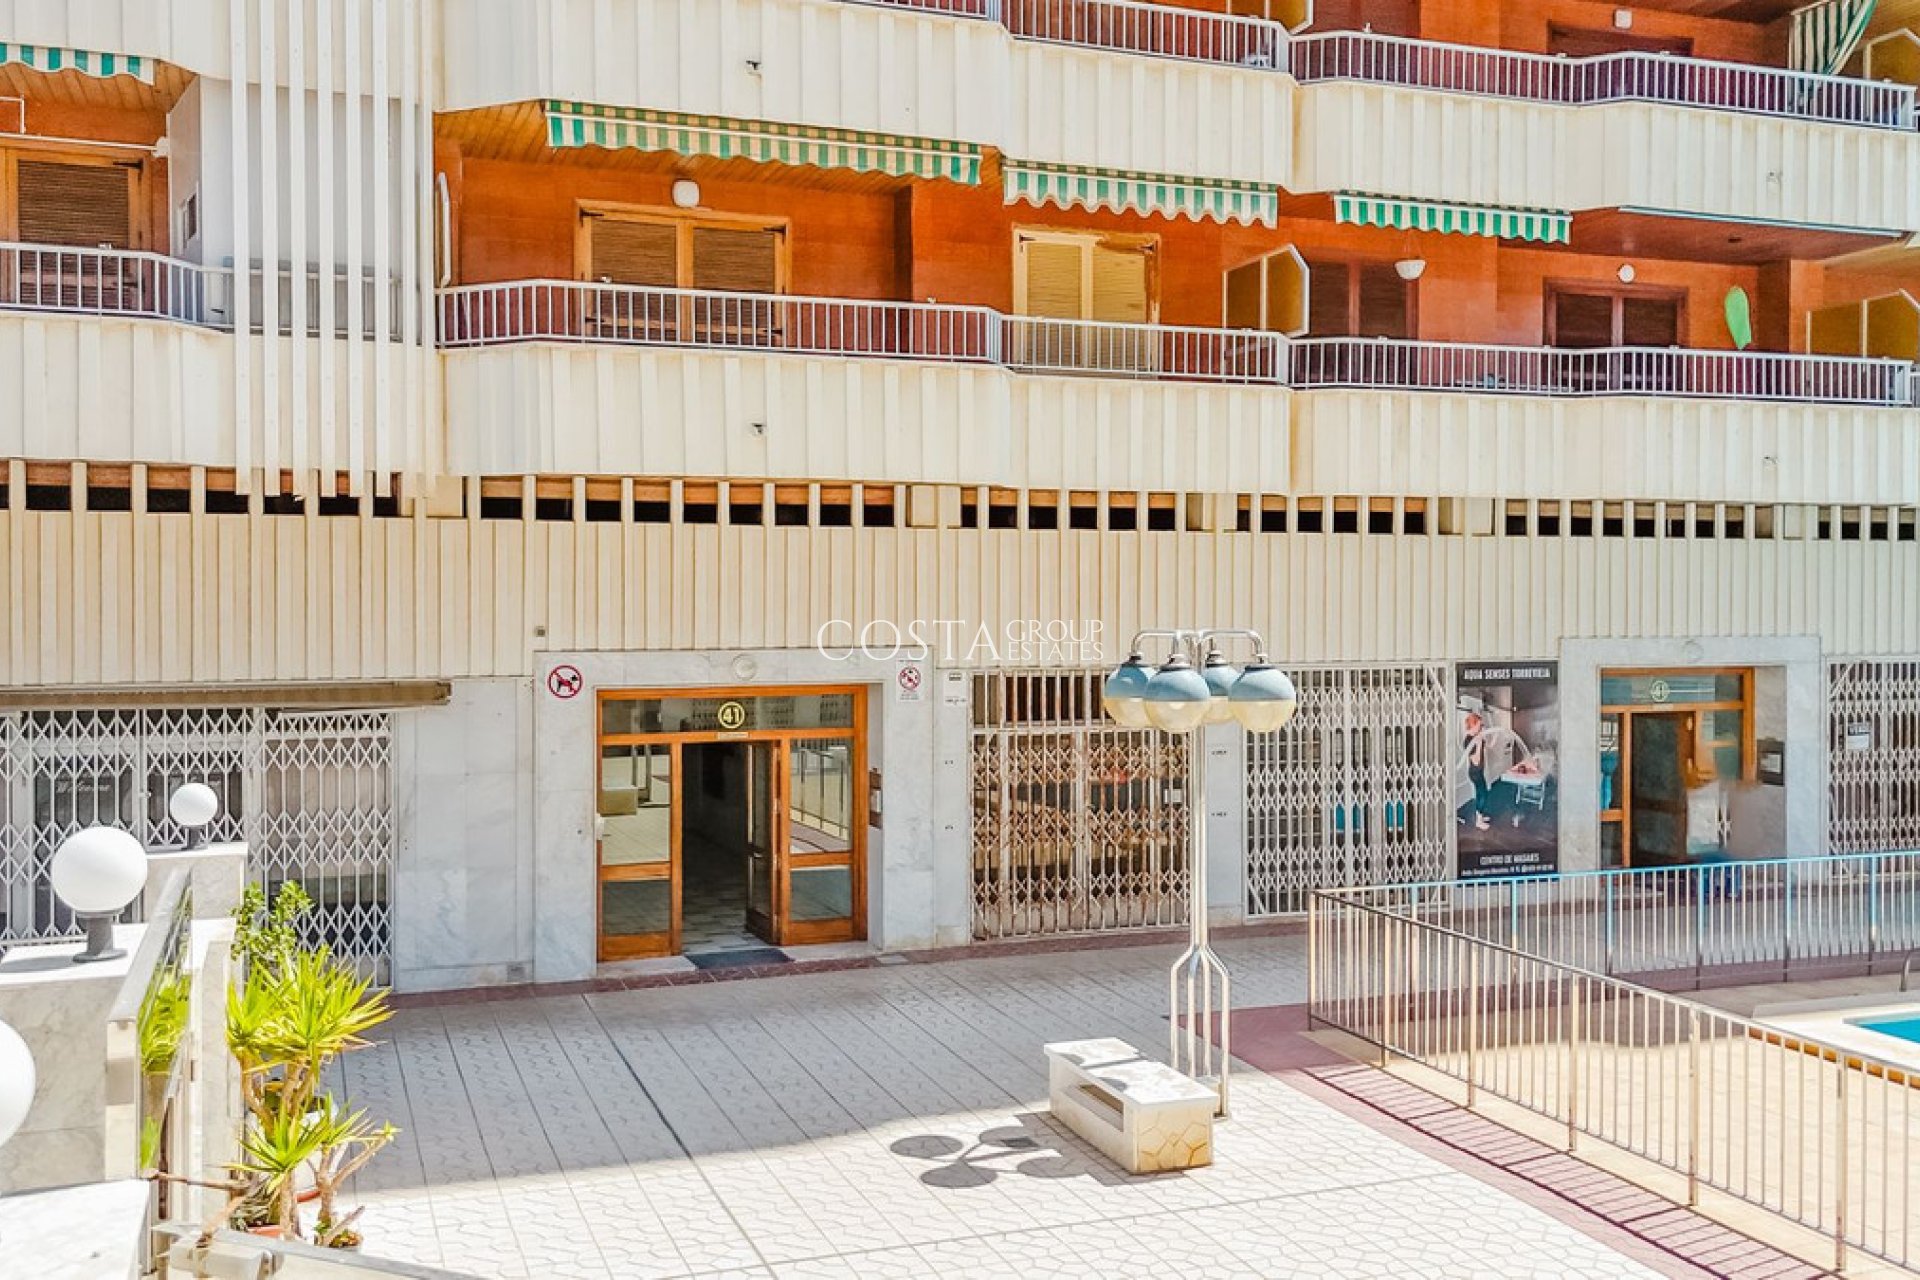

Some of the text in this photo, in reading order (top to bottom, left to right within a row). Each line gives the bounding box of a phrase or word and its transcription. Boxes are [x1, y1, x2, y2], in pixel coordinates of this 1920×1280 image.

[1464, 668, 1483, 680] AQUA
[1484, 668, 1511, 680] SENSES
[722, 706, 740, 723] 41
